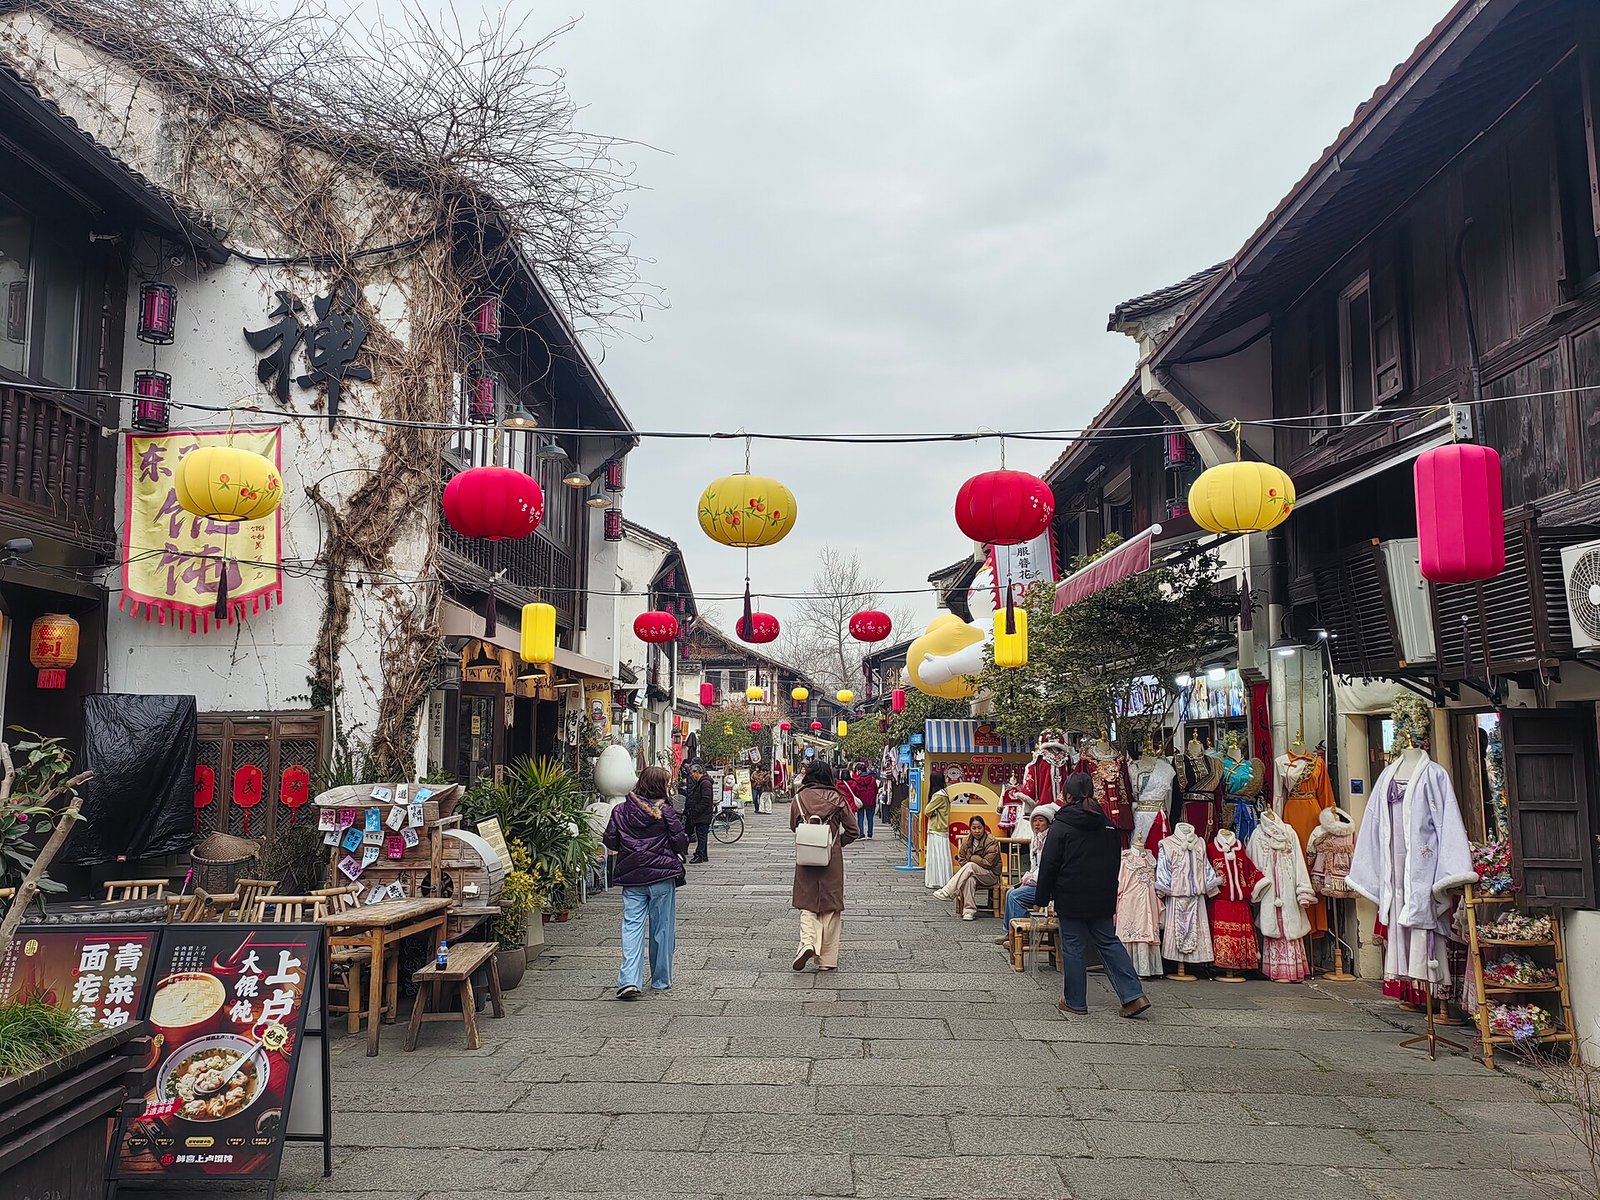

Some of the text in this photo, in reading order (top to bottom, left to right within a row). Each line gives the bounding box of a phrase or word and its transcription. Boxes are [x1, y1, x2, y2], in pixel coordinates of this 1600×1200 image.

[229, 949, 263, 1023] 大馄饨
[257, 949, 302, 1026] 上卢
